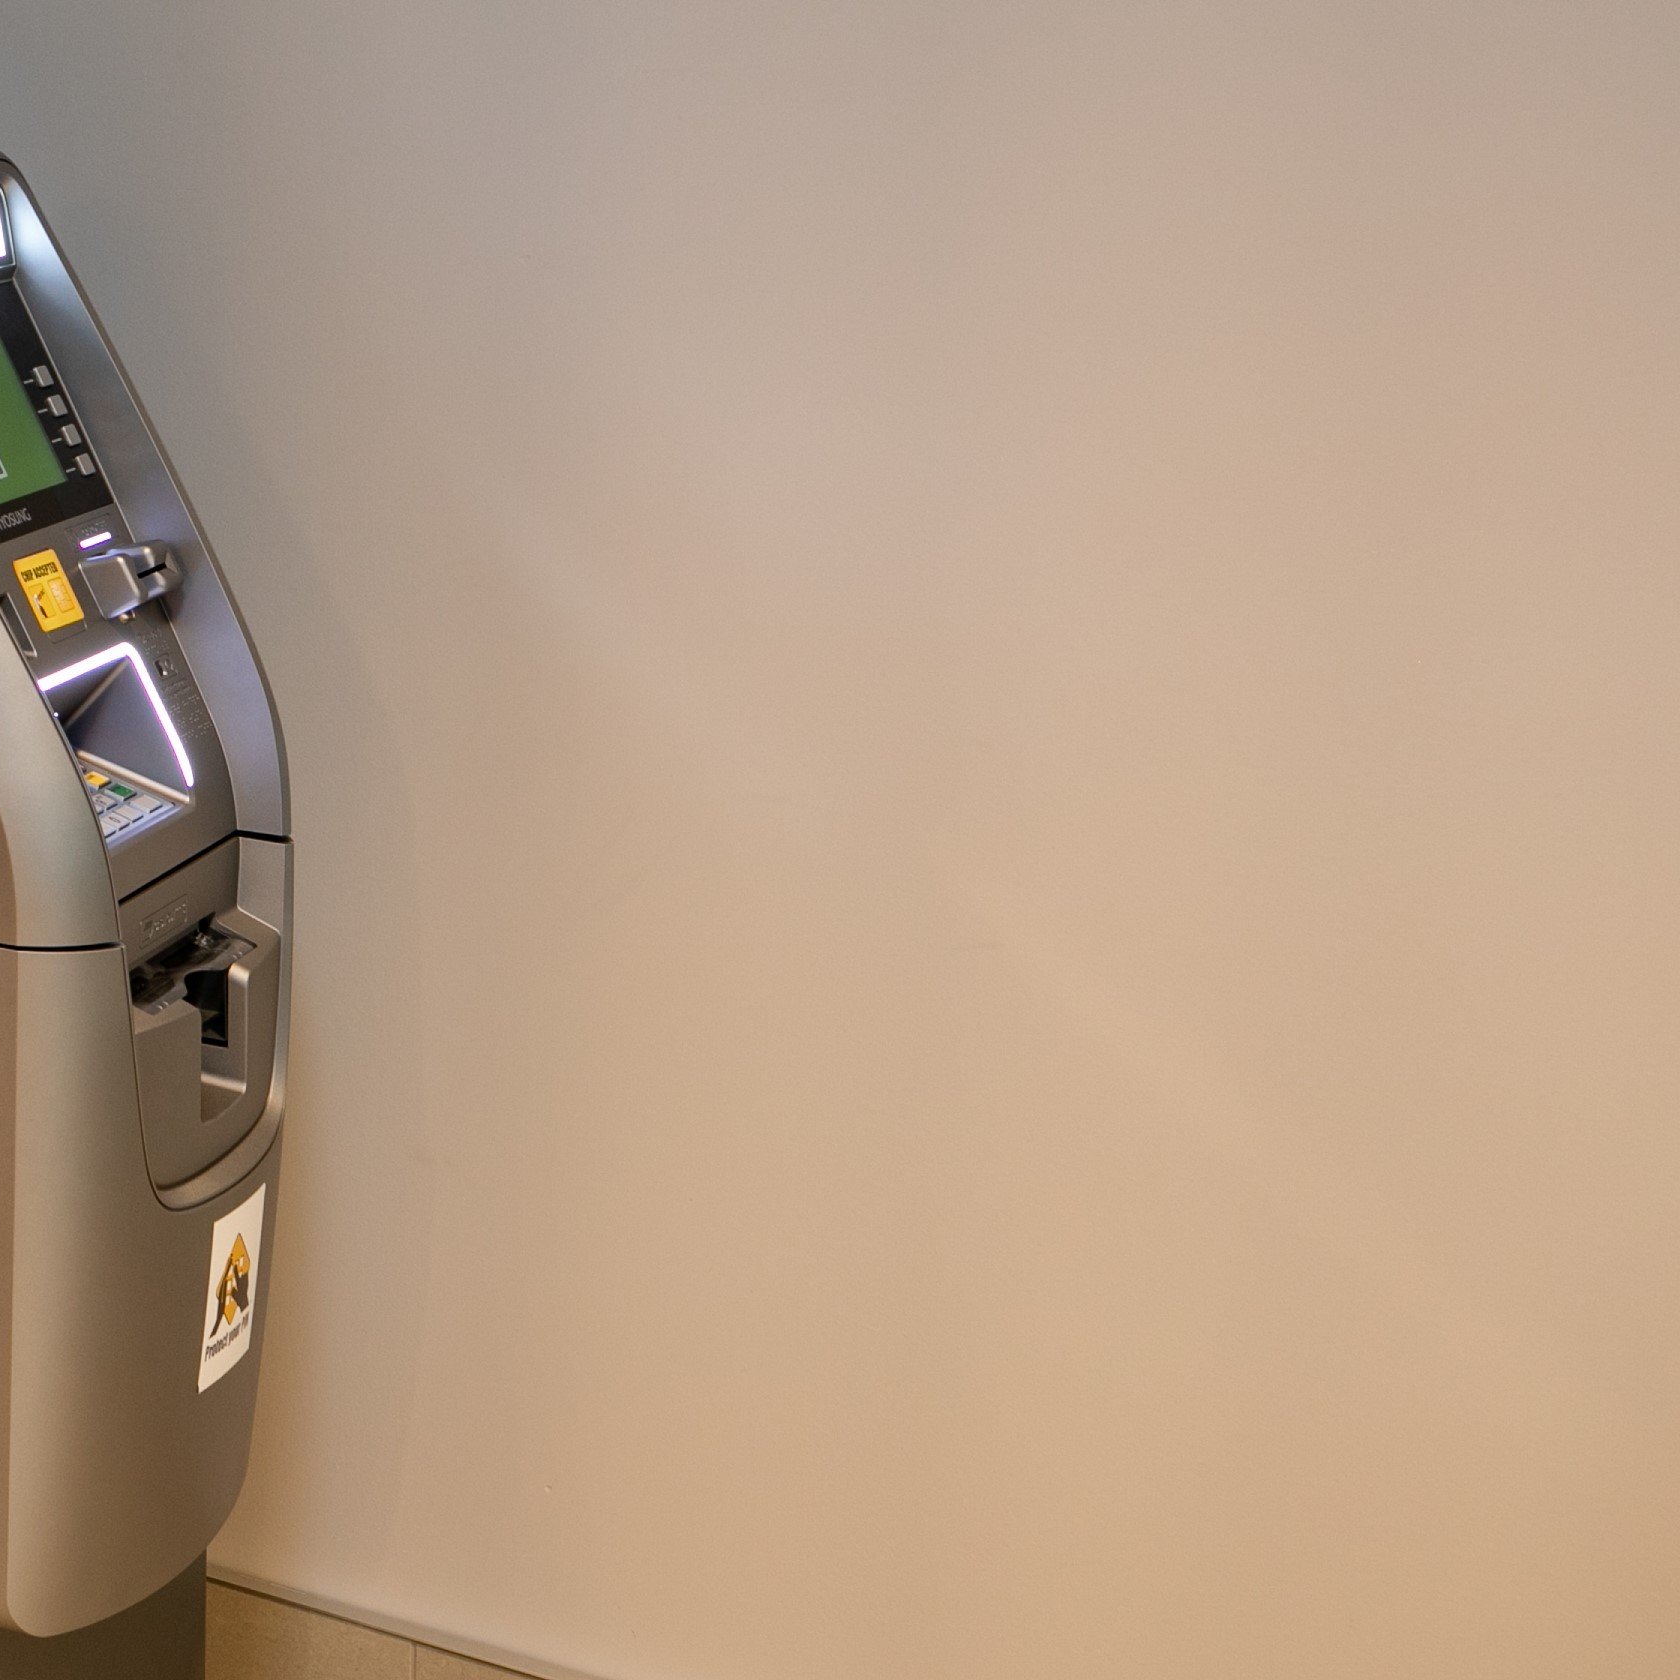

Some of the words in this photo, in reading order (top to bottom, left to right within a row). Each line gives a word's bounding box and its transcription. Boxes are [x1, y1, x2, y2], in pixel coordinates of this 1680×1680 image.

[20, 568, 34, 583] CHIP
[204, 1332, 228, 1362] Protect
[228, 1322, 241, 1346] your
